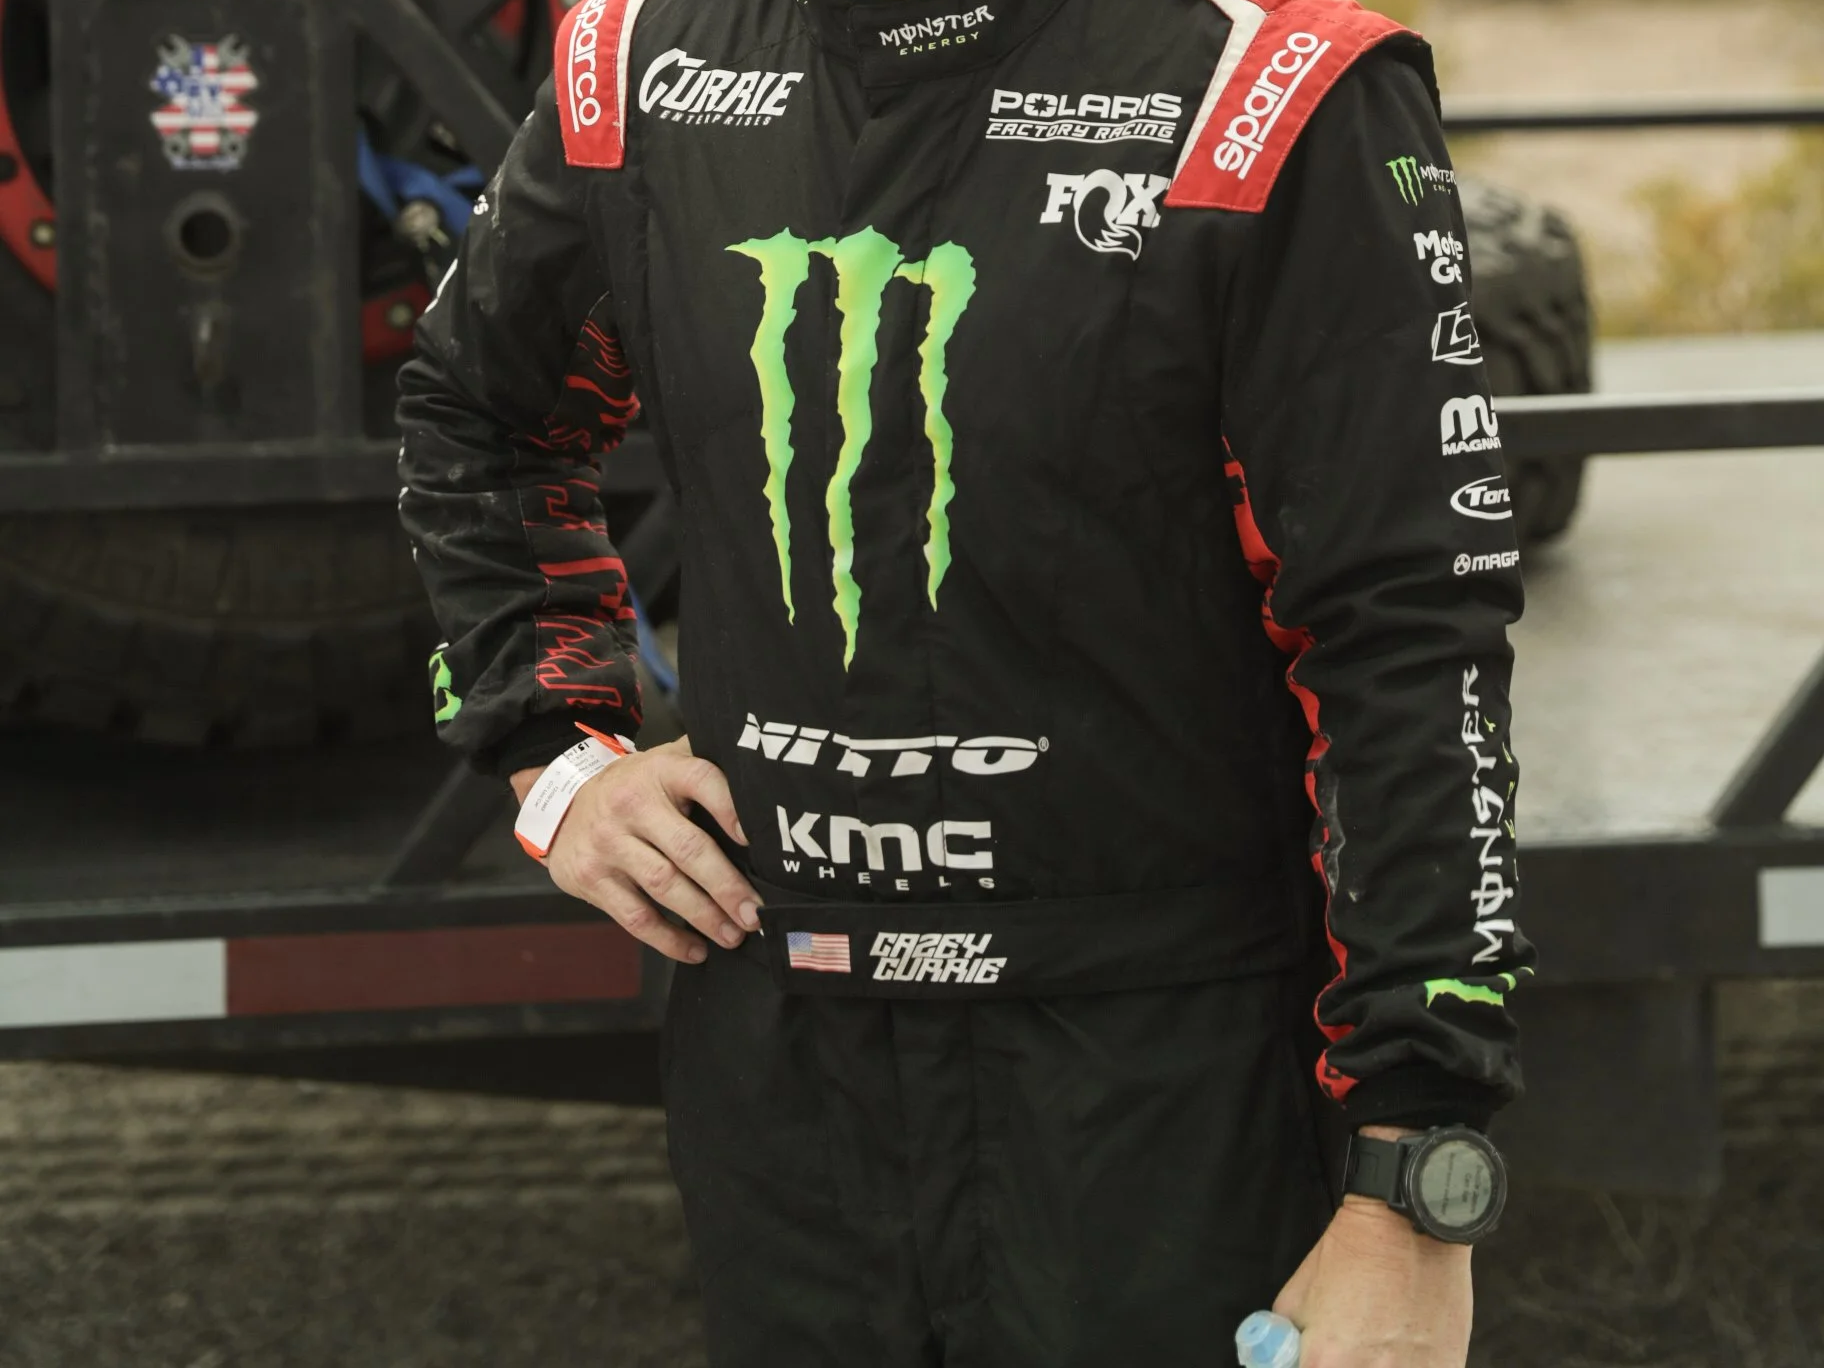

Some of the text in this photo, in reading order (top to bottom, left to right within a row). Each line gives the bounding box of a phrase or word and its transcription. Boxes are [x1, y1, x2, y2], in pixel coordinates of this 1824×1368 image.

[879, 5, 995, 47] MONSTER
[899, 31, 979, 56] ENERGY
[638, 47, 804, 116] CURRIE
[659, 109, 772, 127] ENTERPRISES
[991, 89, 1182, 120] POLARIS
[1213, 32, 1319, 180] sparco
[986, 122, 1176, 141] FACTORY RACING
[1040, 168, 1171, 261] FOX
[736, 712, 1039, 778] NITTO
[783, 859, 996, 892] WHEELS
